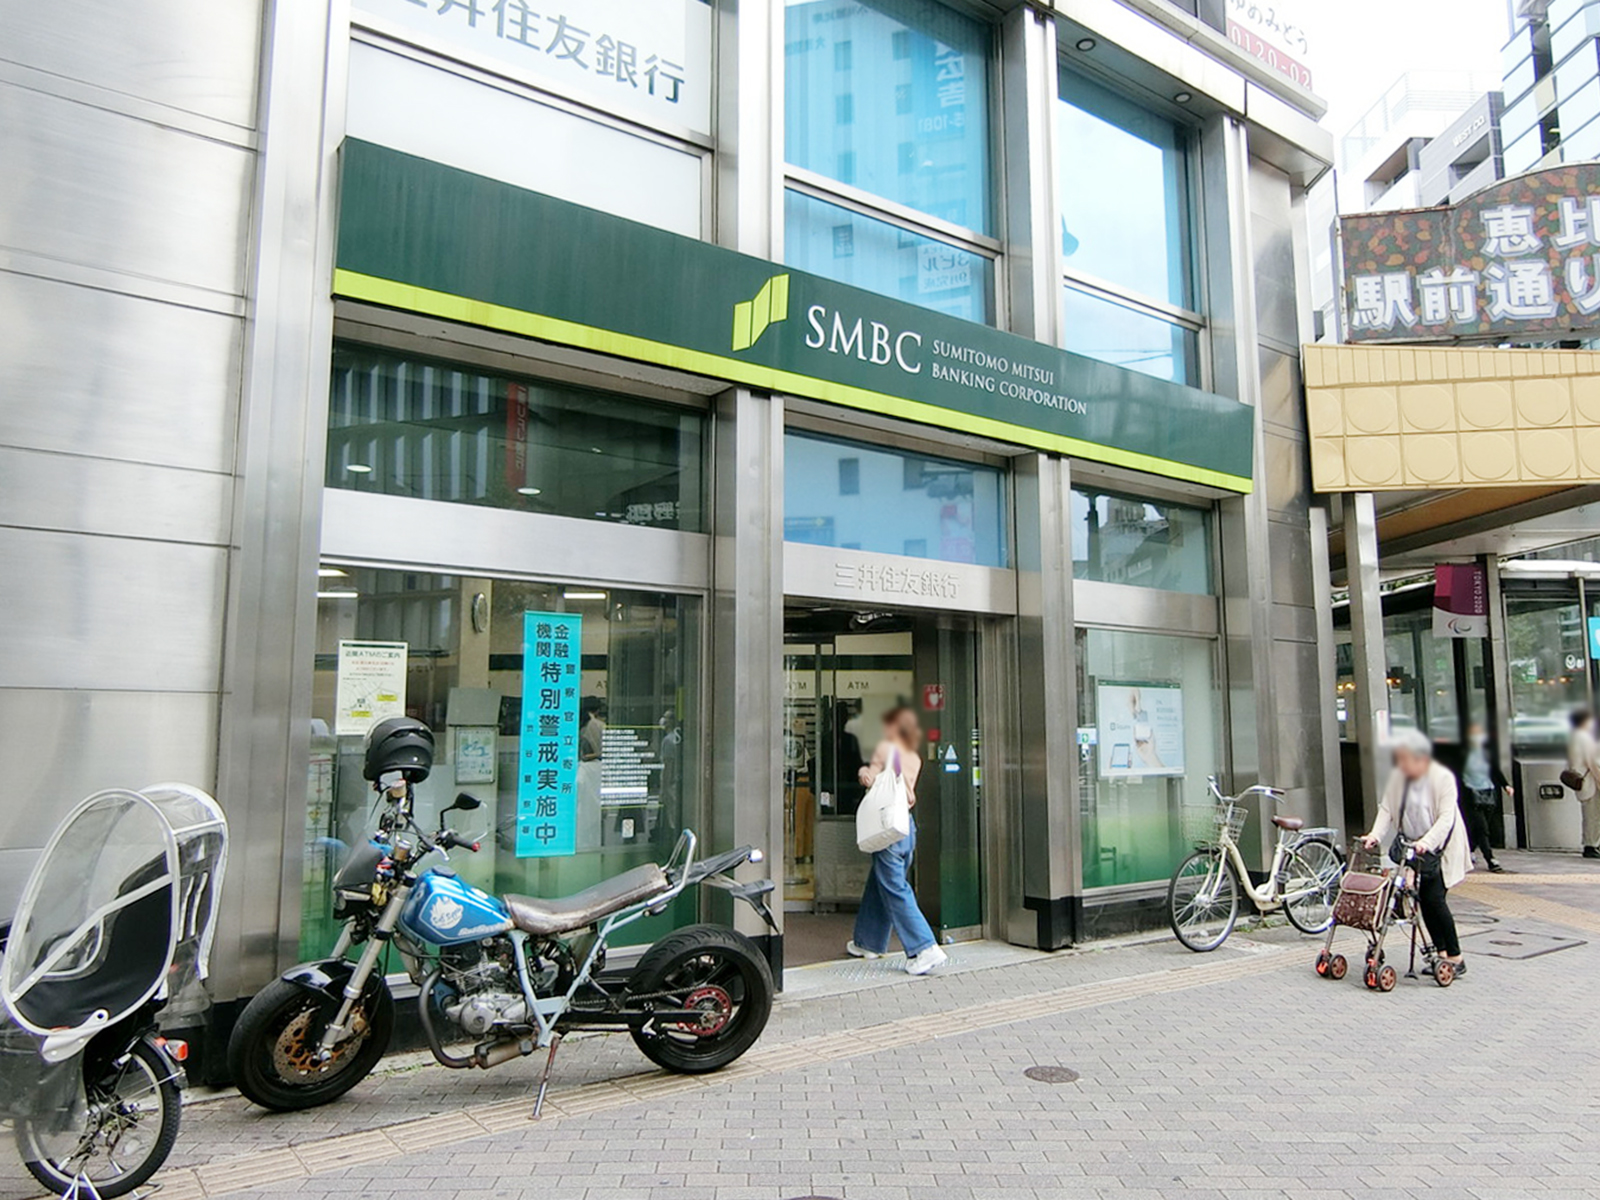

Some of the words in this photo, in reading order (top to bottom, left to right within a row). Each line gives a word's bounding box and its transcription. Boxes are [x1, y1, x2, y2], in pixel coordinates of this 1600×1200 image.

[405, 0, 685, 104] 井住友銀行
[805, 304, 922, 374] SMBC
[932, 339, 1008, 373] SUMITOMO
[1011, 362, 1054, 385] MITSUI
[932, 363, 995, 393] BANKING
[999, 381, 1087, 416] CORPORATION
[833, 562, 960, 599] 三井住友銀行
[1473, 570, 1483, 595] TOKYO
[1474, 596, 1483, 614] 2020
[535, 622, 552, 658] 機関
[554, 623, 569, 658] 金融
[846, 681, 870, 690] ATM
[535, 661, 562, 845] 特別警戒実施中
